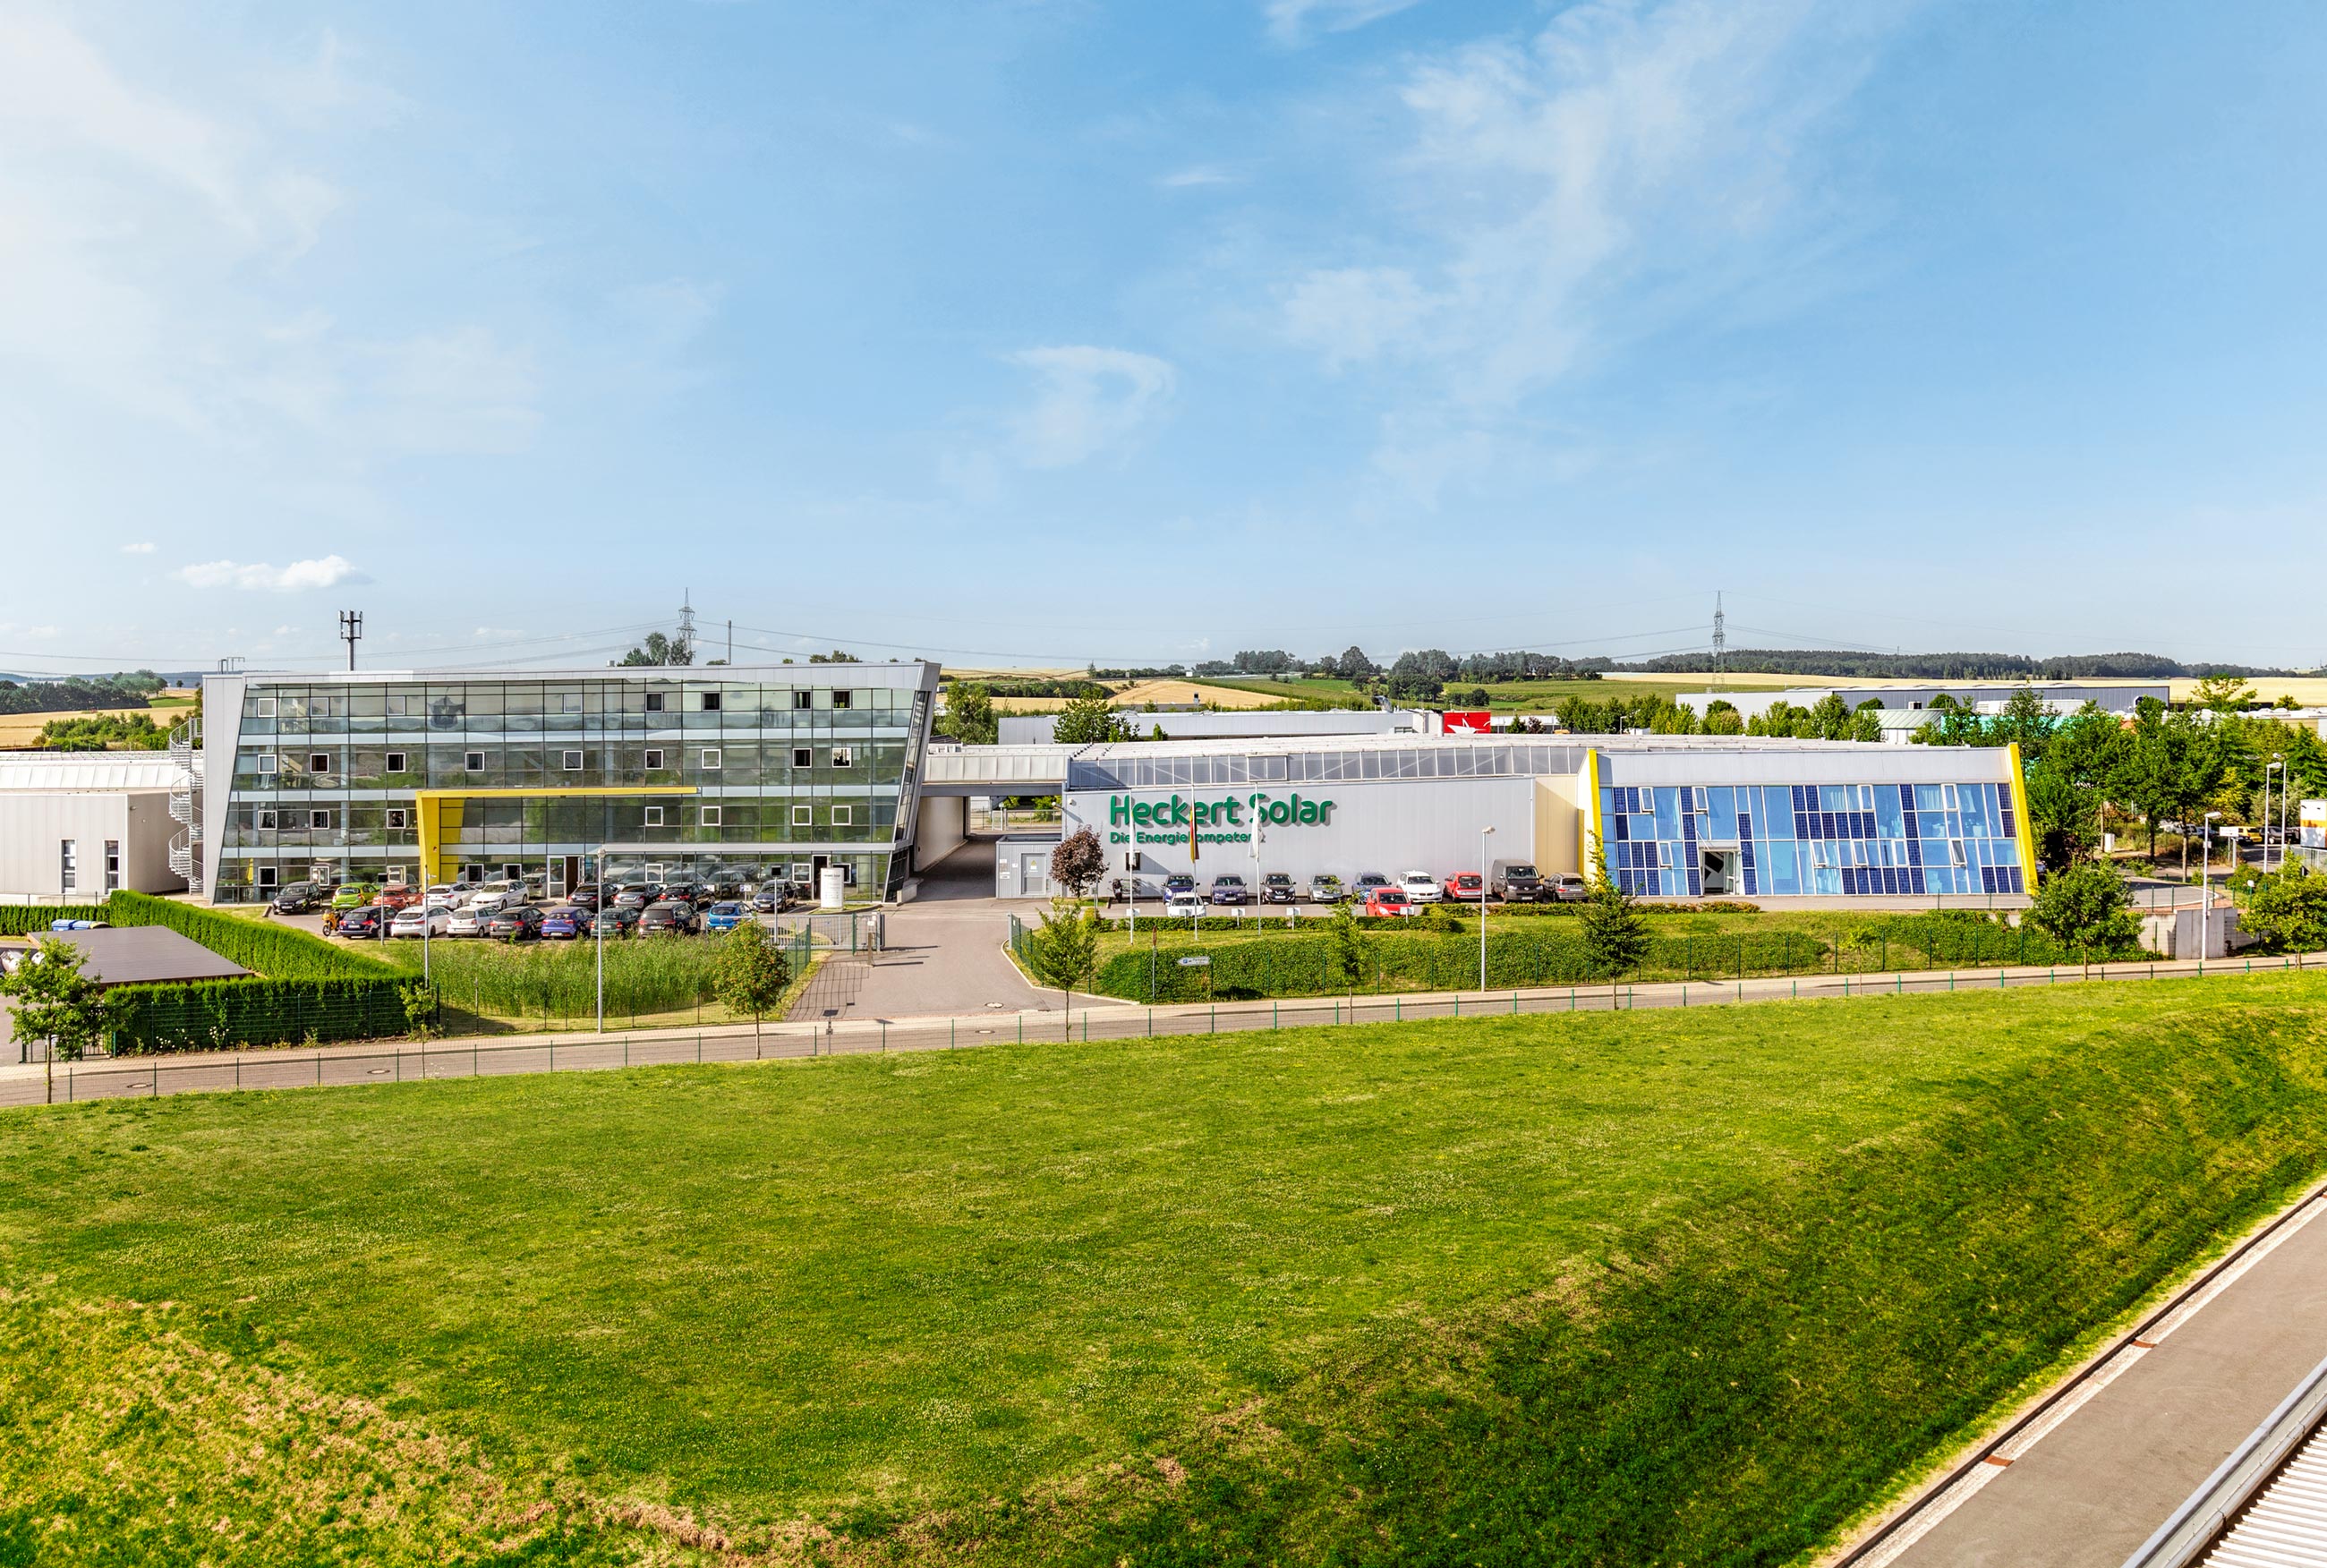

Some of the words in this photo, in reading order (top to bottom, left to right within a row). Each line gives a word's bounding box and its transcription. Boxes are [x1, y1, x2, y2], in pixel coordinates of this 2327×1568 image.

[1110, 794, 1240, 824] Heckert
[1249, 793, 1333, 824] Solar
[1110, 831, 1130, 843] Die
